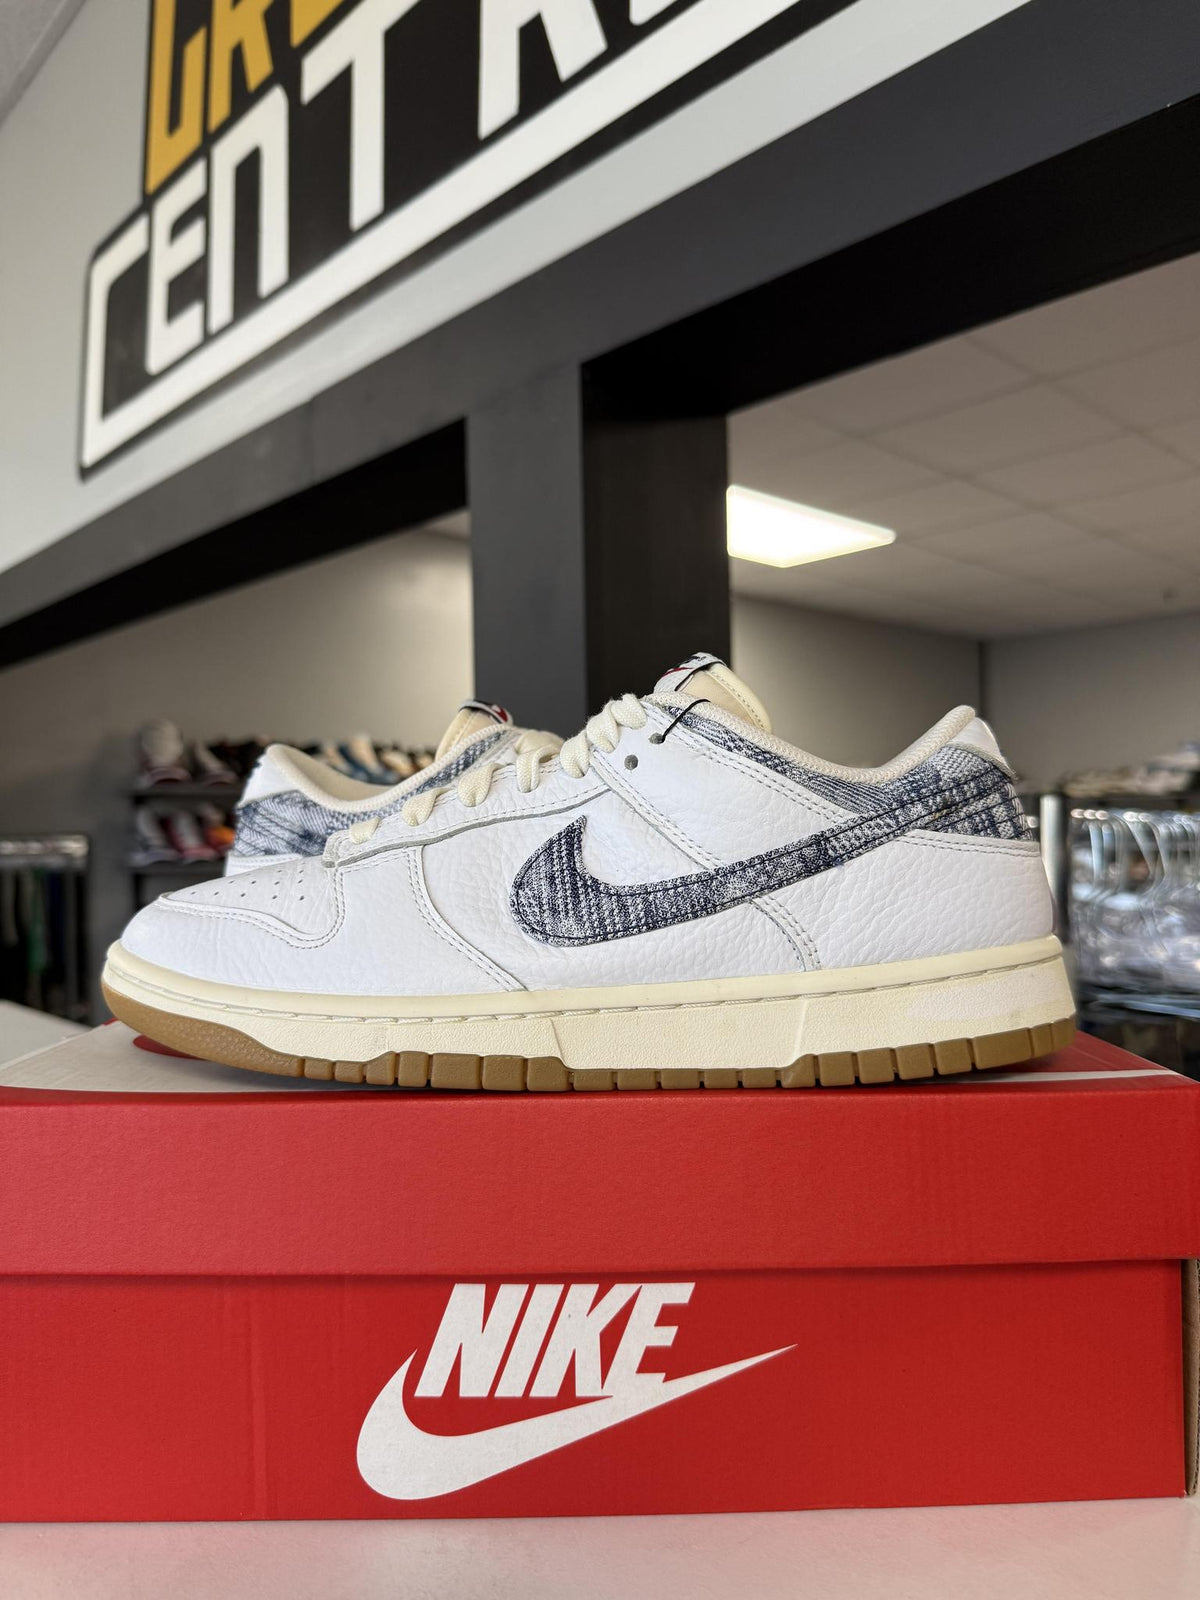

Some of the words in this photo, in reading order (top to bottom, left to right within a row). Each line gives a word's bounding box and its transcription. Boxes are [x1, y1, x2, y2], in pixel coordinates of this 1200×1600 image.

[146, 0, 346, 195] CR
[83, 0, 690, 467] CENTR
[414, 1282, 695, 1398] NIKE
